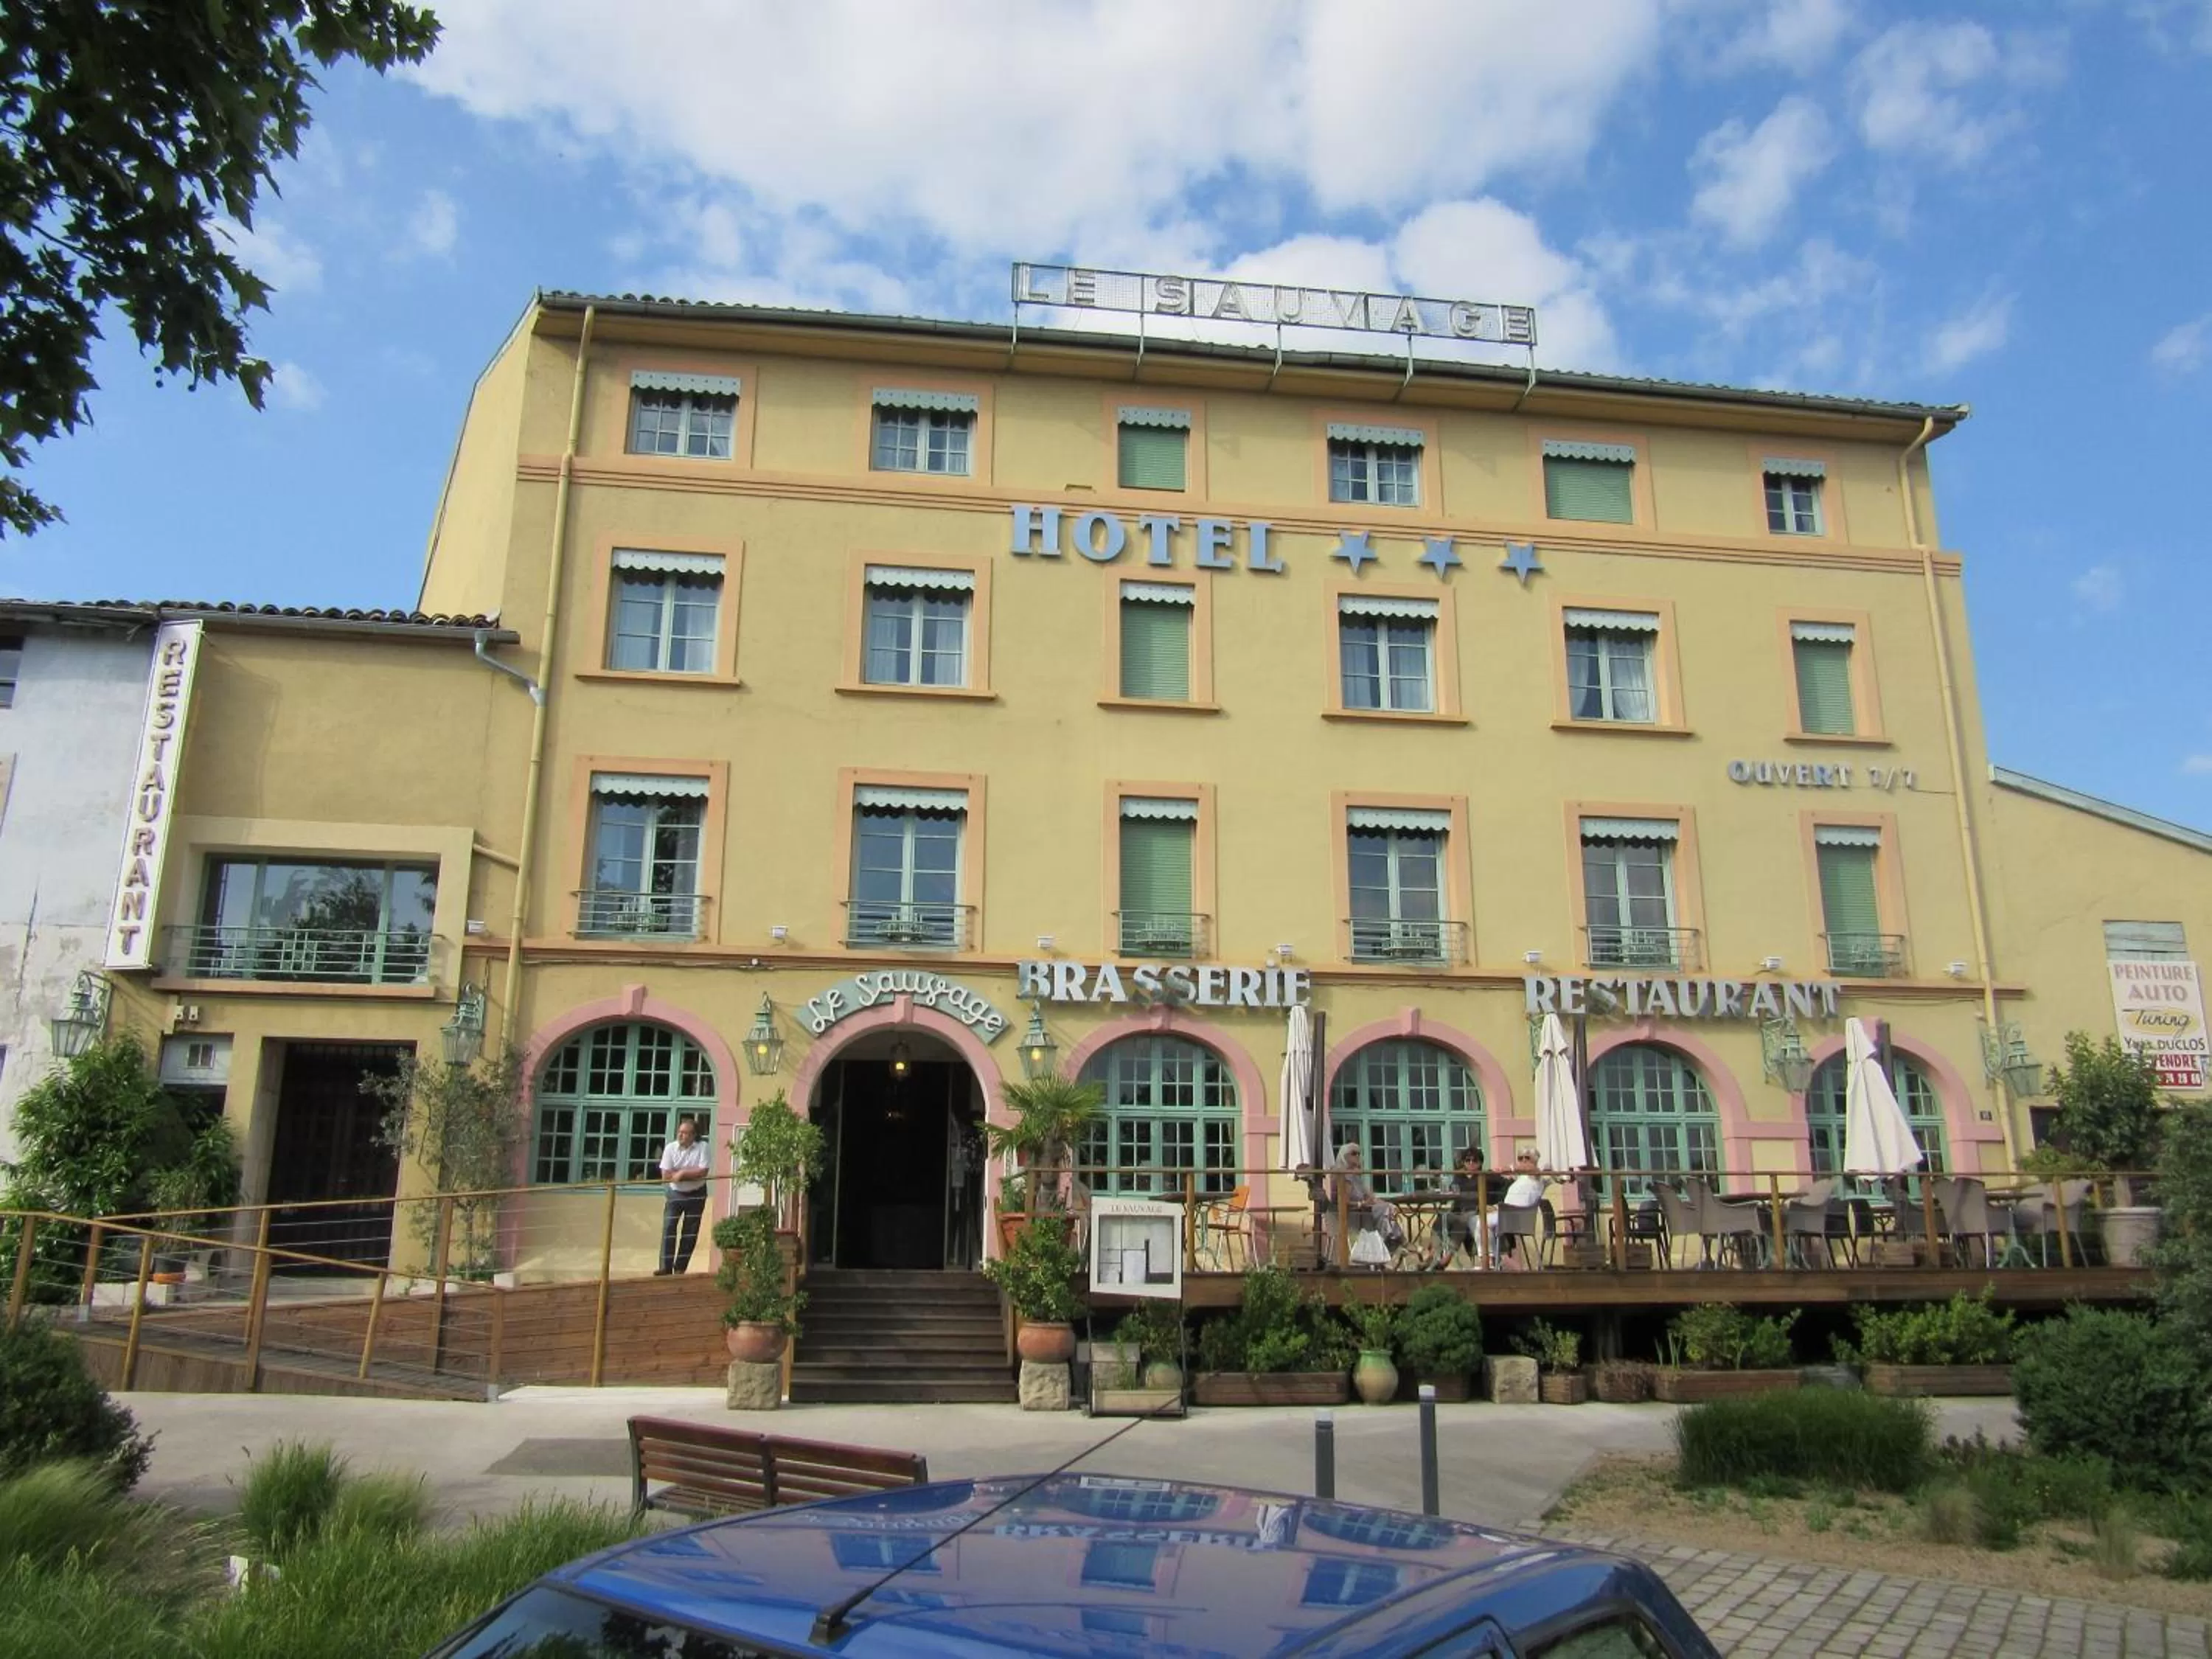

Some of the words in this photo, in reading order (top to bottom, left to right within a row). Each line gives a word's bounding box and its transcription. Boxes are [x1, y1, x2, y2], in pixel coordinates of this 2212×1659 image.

[1017, 264, 1096, 305] LE
[1154, 276, 1532, 341] SAUVAGE
[1010, 504, 1284, 573] HOTEL
[119, 639, 187, 956] RESTAURANT
[1728, 760, 1852, 788] OUVERT
[1868, 765, 1916, 791] 7/7
[1016, 960, 1311, 1007] BRASSERIE
[2113, 964, 2195, 981] PEINTURE
[2128, 984, 2188, 1002] AUTO
[807, 989, 844, 1033] Le
[855, 972, 1004, 1032] Sauvage
[1524, 975, 1842, 1019] RESTAURANT
[2122, 1008, 2191, 1038] Tuning
[2157, 1037, 2206, 1051] DUCLOS
